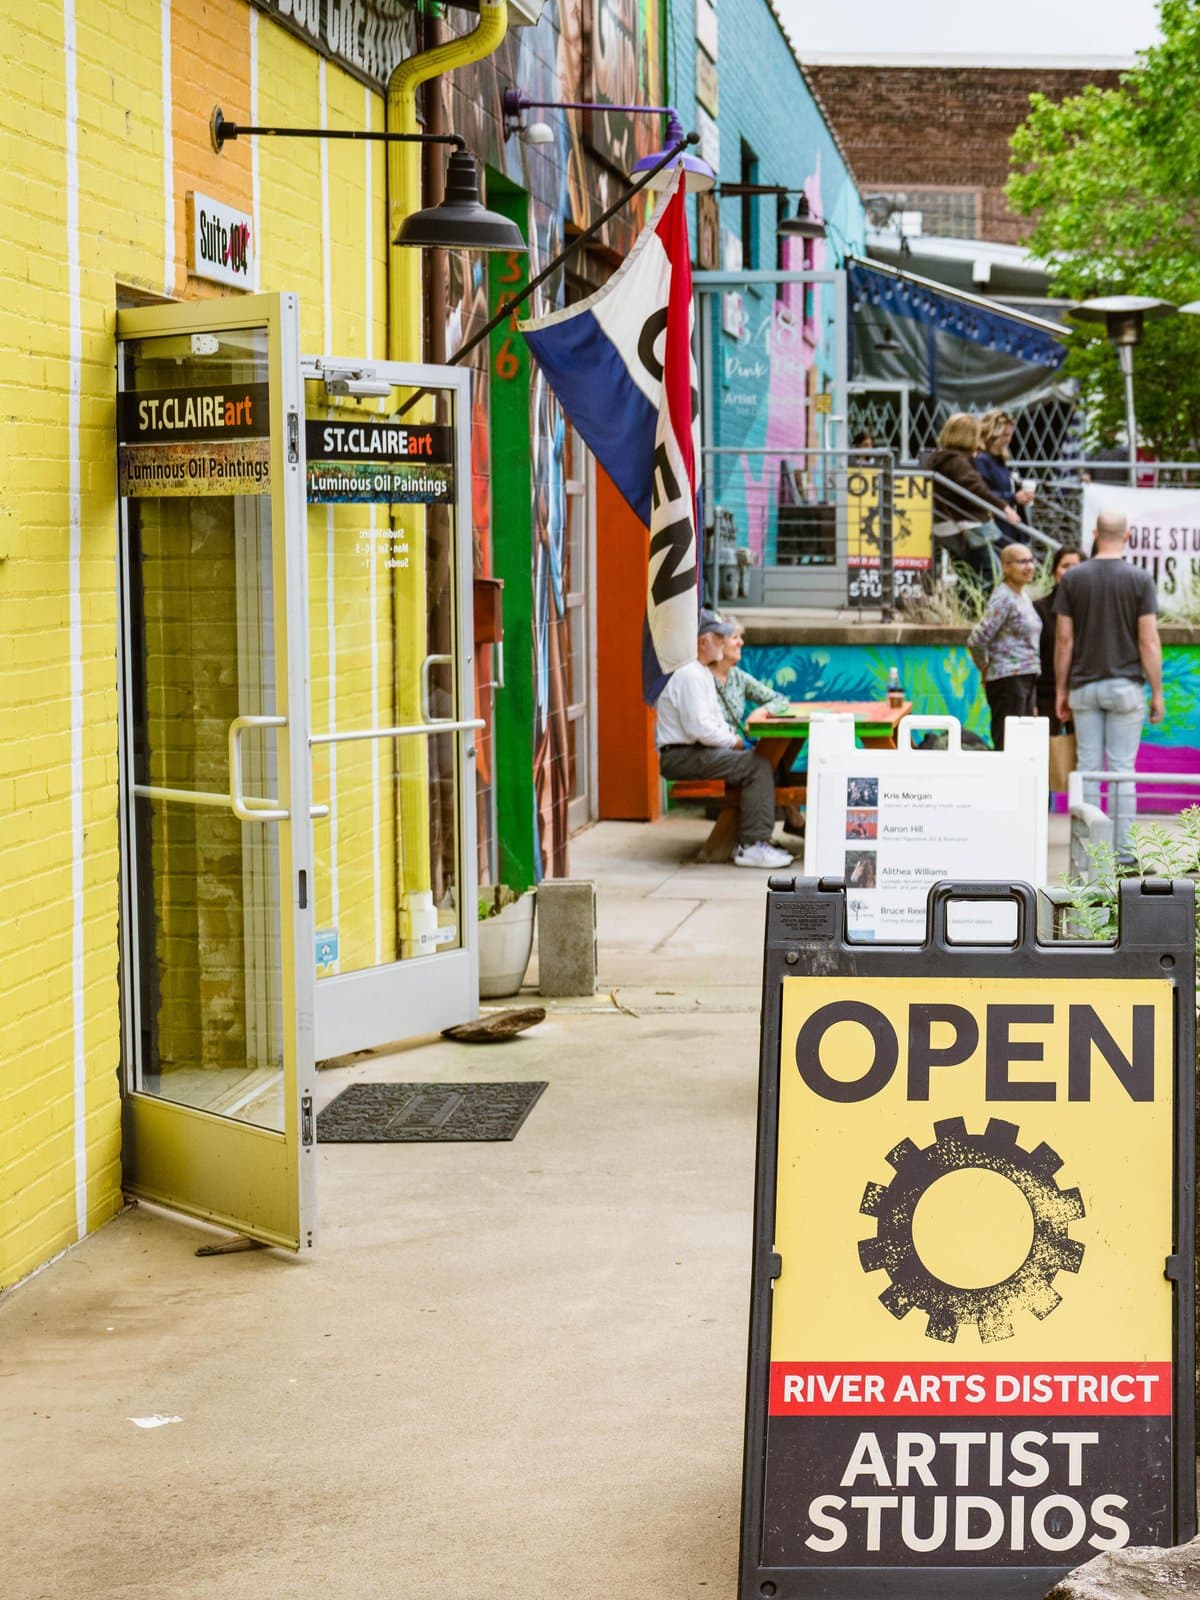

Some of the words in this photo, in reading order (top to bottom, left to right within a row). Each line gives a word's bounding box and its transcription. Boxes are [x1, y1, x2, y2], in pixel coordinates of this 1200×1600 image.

[200, 209, 228, 267] Suite
[138, 395, 253, 431] ST.CLAIREart
[323, 427, 433, 455] ST.CLAIREart
[127, 460, 185, 481] Luminous
[188, 457, 206, 479] Oil
[209, 456, 269, 483] Paintings
[311, 474, 371, 491] Luminous
[374, 475, 391, 491] Oil
[394, 476, 447, 496] Paintings
[1128, 526, 1161, 551] ORE
[857, 568, 916, 585] ARST
[849, 582, 922, 598] STUIOS
[883, 791, 900, 801] Kris
[901, 791, 933, 803] Morgan
[883, 825, 908, 833] Aaron
[910, 825, 924, 833] Hill
[913, 867, 948, 876] Williams
[880, 906, 905, 916] Bruce
[795, 1000, 1156, 1104] OPEN
[783, 1375, 885, 1402] RIVER
[892, 1374, 987, 1402] ARTS
[994, 1374, 1160, 1402] DISTRICT
[839, 1431, 1099, 1488] ARTIST
[803, 1494, 1131, 1553] STUDIOS
